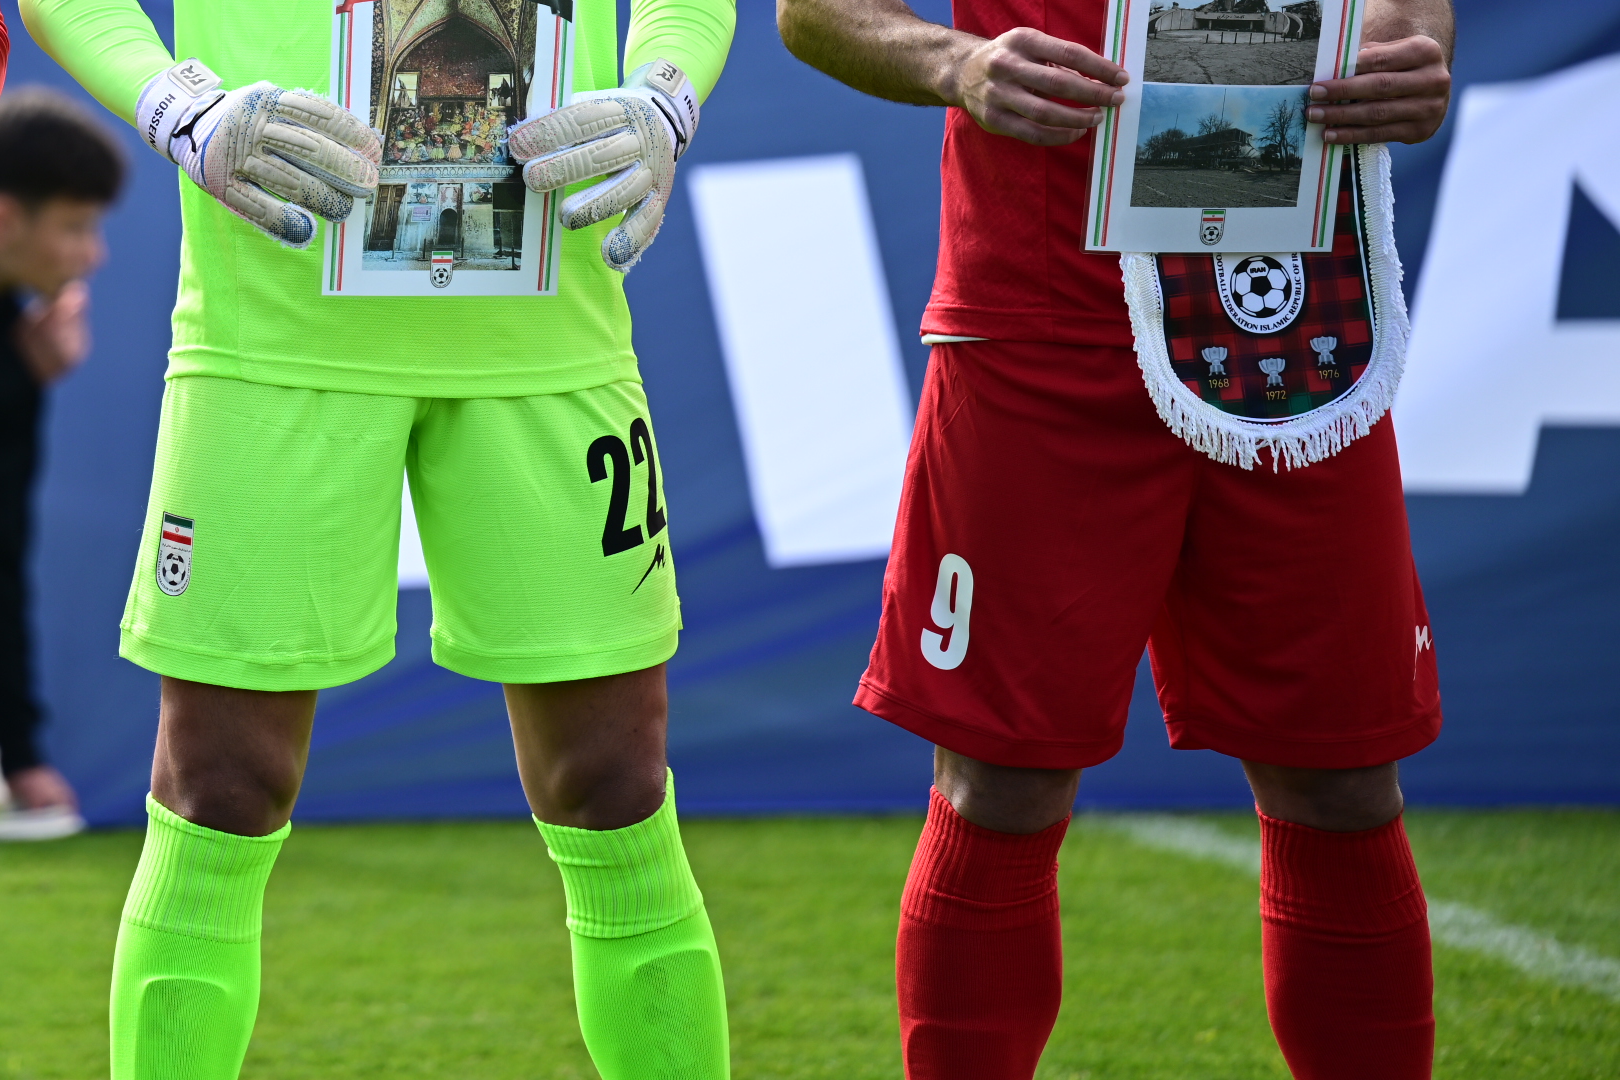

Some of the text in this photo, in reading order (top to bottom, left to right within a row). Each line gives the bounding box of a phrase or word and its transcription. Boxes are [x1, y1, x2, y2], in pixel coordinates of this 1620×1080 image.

[1291, 252, 1299, 262] IR
[1249, 266, 1267, 274] IRAN
[1292, 263, 1300, 275] OF
[1289, 276, 1302, 316] REPUBLIC
[1223, 294, 1258, 331] FEDERATION
[1260, 313, 1292, 332] ISLAMIC
[1318, 368, 1340, 380] 1976
[1208, 378, 1230, 389] 1968
[1265, 390, 1287, 401] 1972
[920, 552, 974, 671] 9
